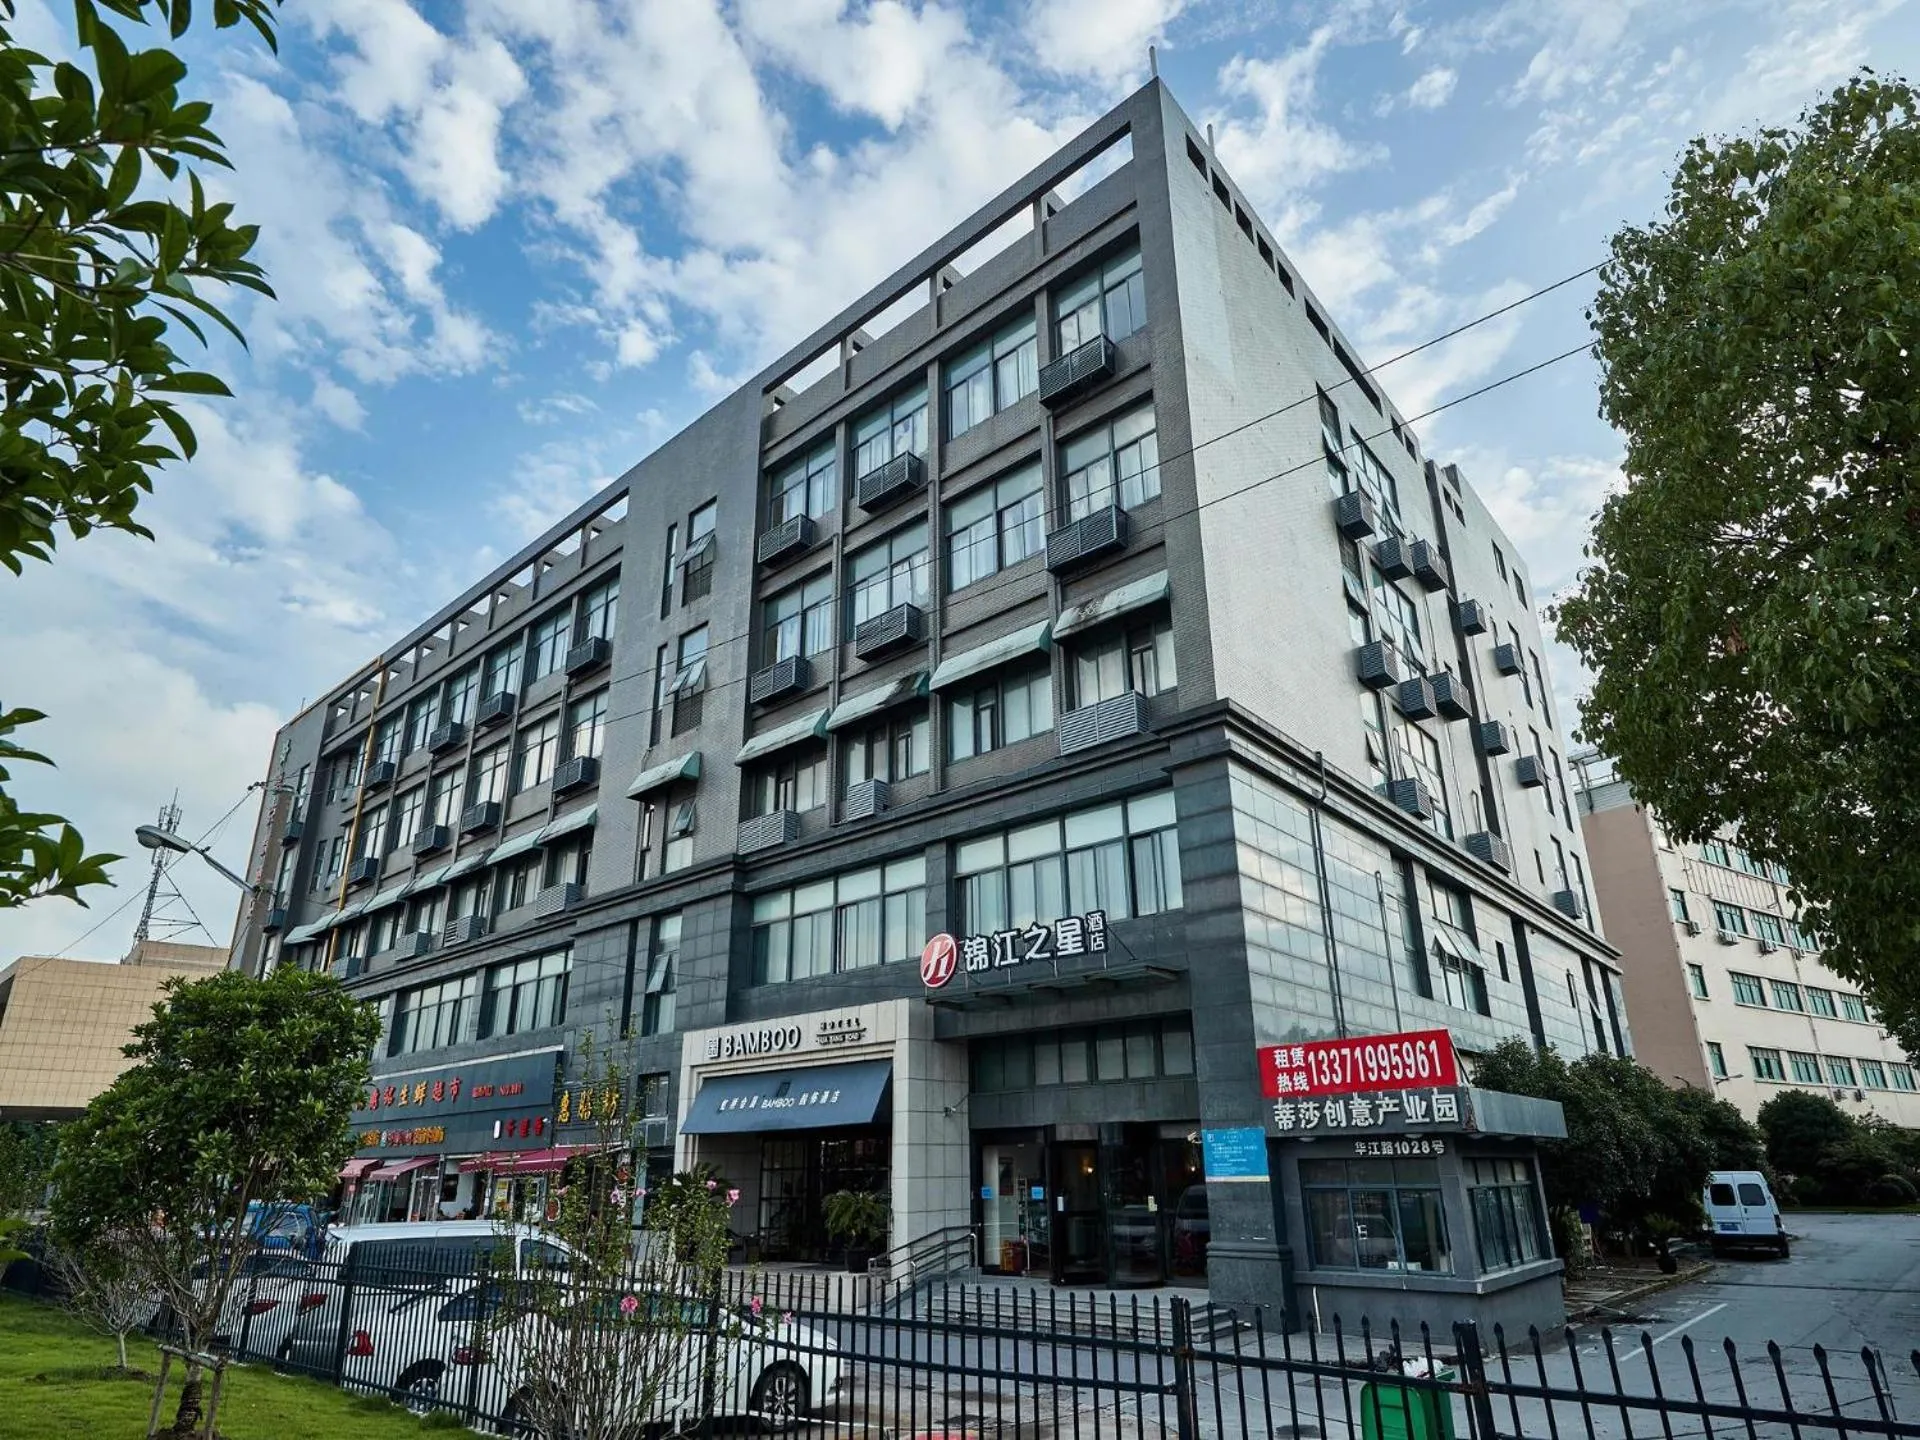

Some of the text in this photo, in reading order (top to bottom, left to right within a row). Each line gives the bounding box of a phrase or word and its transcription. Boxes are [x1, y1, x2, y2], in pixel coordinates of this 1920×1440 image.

[962, 917, 1085, 972] 锦江之星
[1087, 911, 1106, 953] 酒店
[725, 1026, 801, 1058] BAMBOO
[1274, 1046, 1305, 1069] 租赁
[1308, 1039, 1442, 1086] 13371995961
[1277, 1071, 1310, 1094] 热线
[761, 1097, 796, 1109] BAMBOO
[1273, 1093, 1460, 1132] 蒂莎创意产业园
[1354, 1139, 1445, 1156] 华江路1028号
